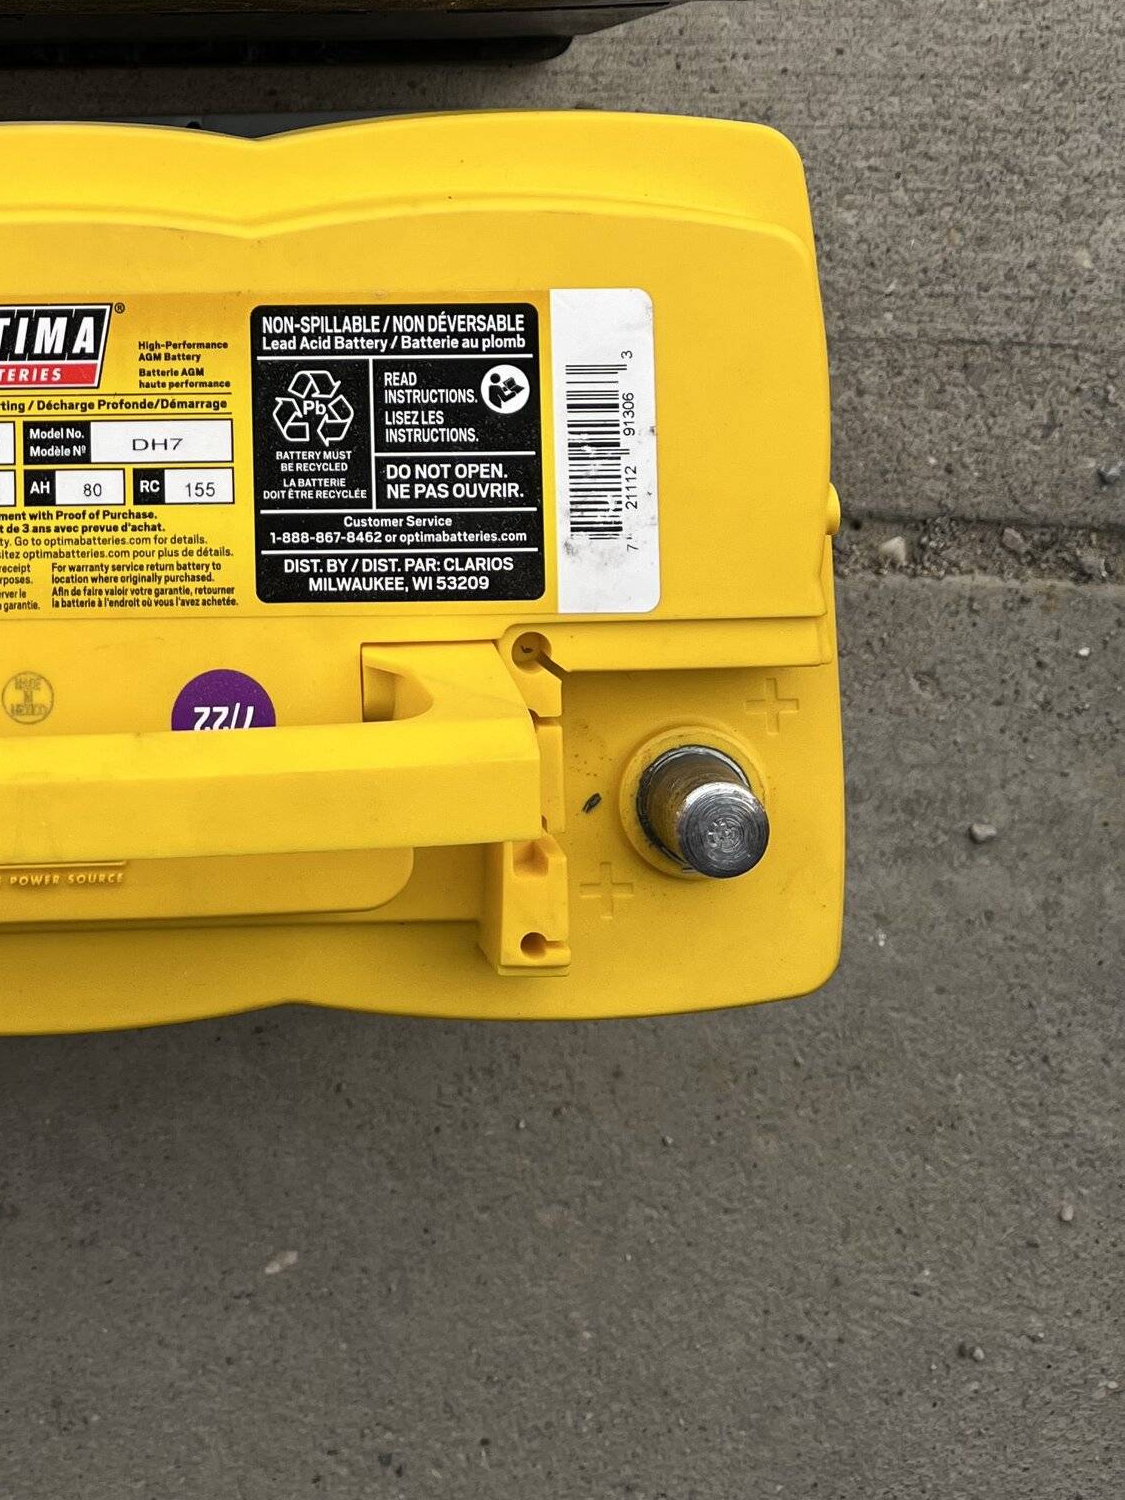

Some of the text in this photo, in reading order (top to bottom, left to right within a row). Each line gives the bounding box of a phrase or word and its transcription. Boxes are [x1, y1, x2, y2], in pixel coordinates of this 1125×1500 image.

[262, 311, 525, 334] NON-SPILLABLE / NON DÉVERSABLE
[138, 340, 228, 352] High-Performance
[262, 335, 388, 352] Lead Acid Battery
[138, 352, 201, 363] AGM Battery
[620, 350, 633, 359] 3
[384, 372, 417, 386] READ
[385, 389, 478, 404] INSTRUCTIONS.
[303, 400, 326, 415] Pb
[622, 393, 635, 436] 91306
[132, 438, 183, 451] DH7
[30, 481, 50, 494] AH
[83, 483, 102, 497] 80
[140, 480, 160, 493] RC
[186, 482, 215, 497] 155
[624, 466, 638, 510] 21112
[29, 510, 53, 521] with
[56, 510, 86, 520] Proof
[88, 509, 100, 520] of
[102, 509, 157, 520] Purchase.
[344, 515, 452, 527] Customer Service
[270, 530, 527, 545] 1-888-867-8462 or optimabatteries.com
[444, 557, 514, 571] CLARIOS
[309, 576, 489, 592] MILWAUKEE, WI 53209
[9, 875, 60, 886] POWER
[68, 873, 124, 884] SOURCE
